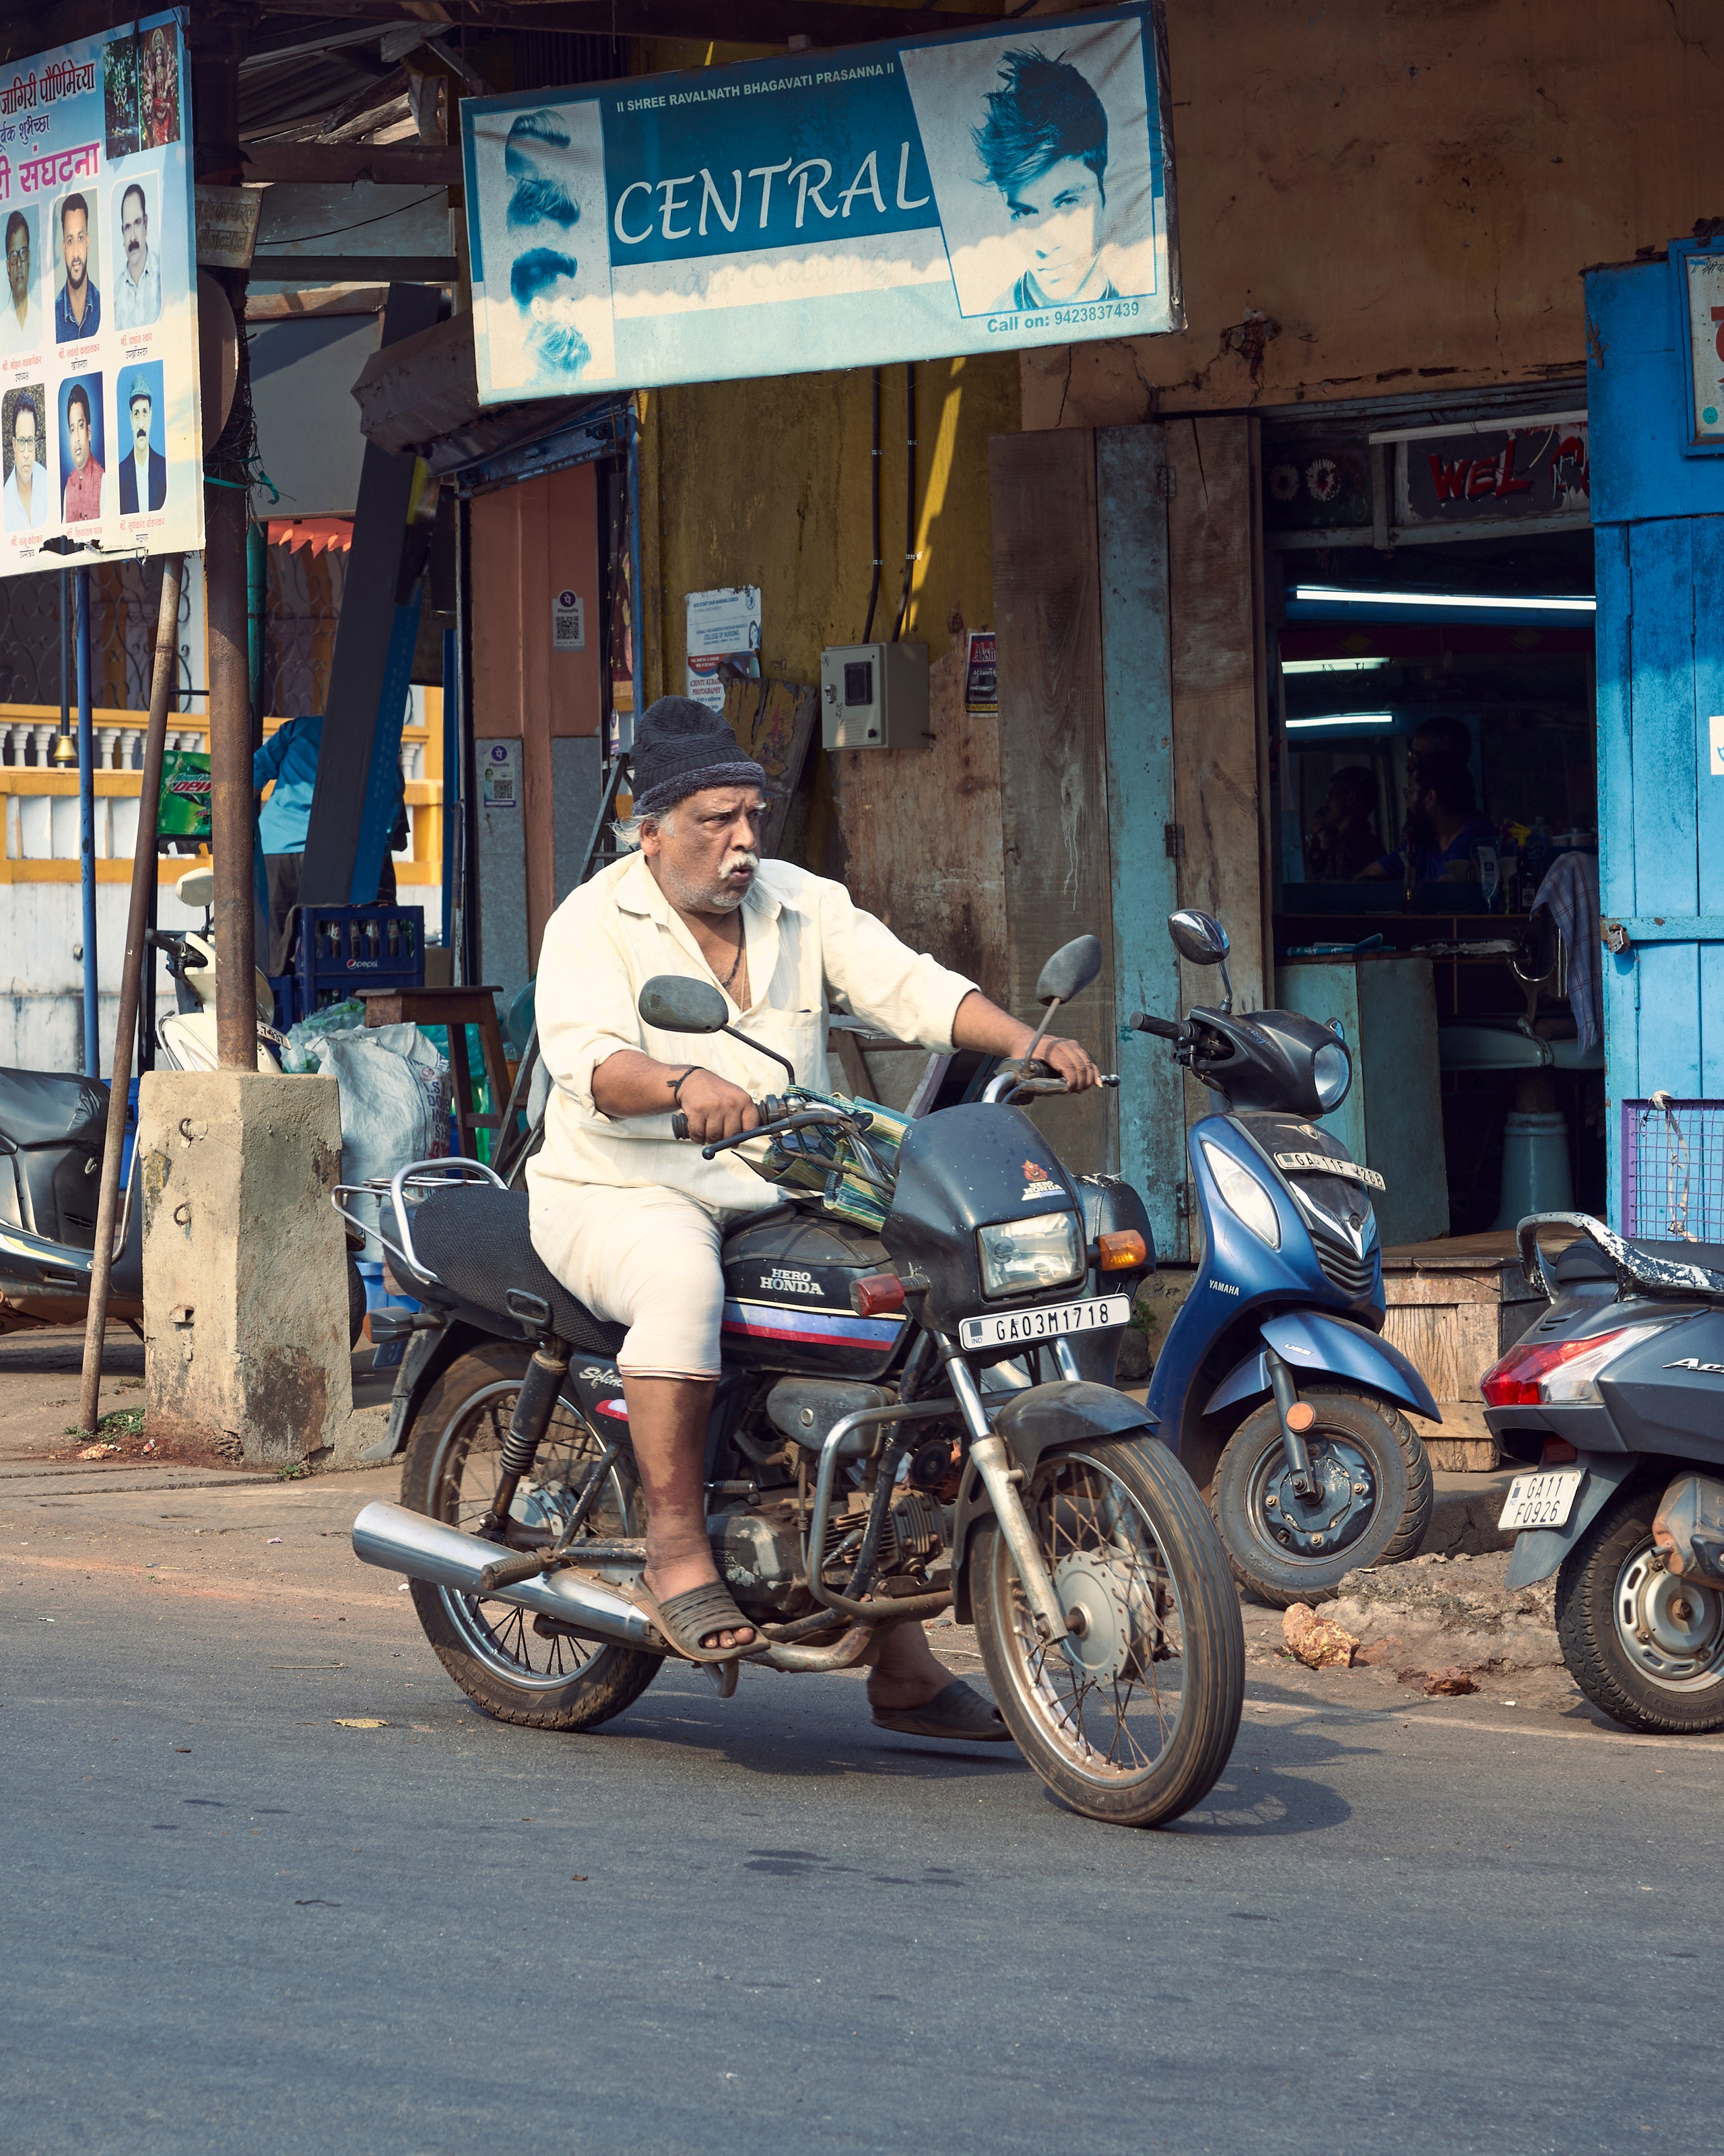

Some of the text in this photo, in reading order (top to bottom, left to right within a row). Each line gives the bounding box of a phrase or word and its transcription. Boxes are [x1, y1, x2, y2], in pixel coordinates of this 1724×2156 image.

[39, 59, 95, 102] पौर्णिमेच्या
[627, 96, 667, 111] SHREE
[669, 85, 740, 106] RAVALNATH
[743, 75, 812, 95] BHAGAVATI
[816, 64, 884, 84] PRASANNA
[19, 142, 100, 192] संघटना
[614, 141, 930, 244] CENTRAL
[987, 302, 1139, 333] Call on: 9423837439
[692, 687, 721, 695] PHOTOGRAPHY
[356, 960, 378, 969] pepsi
[1023, 1184, 1063, 1194] HONDA
[760, 1276, 825, 1295] HONDA
[771, 1268, 811, 1282] HERO
[1209, 1280, 1240, 1296] YAMAHA
[996, 1303, 1108, 1340] GA03M1718
[1527, 1475, 1563, 1499] GA11
[1513, 1500, 1560, 1525] F0926
